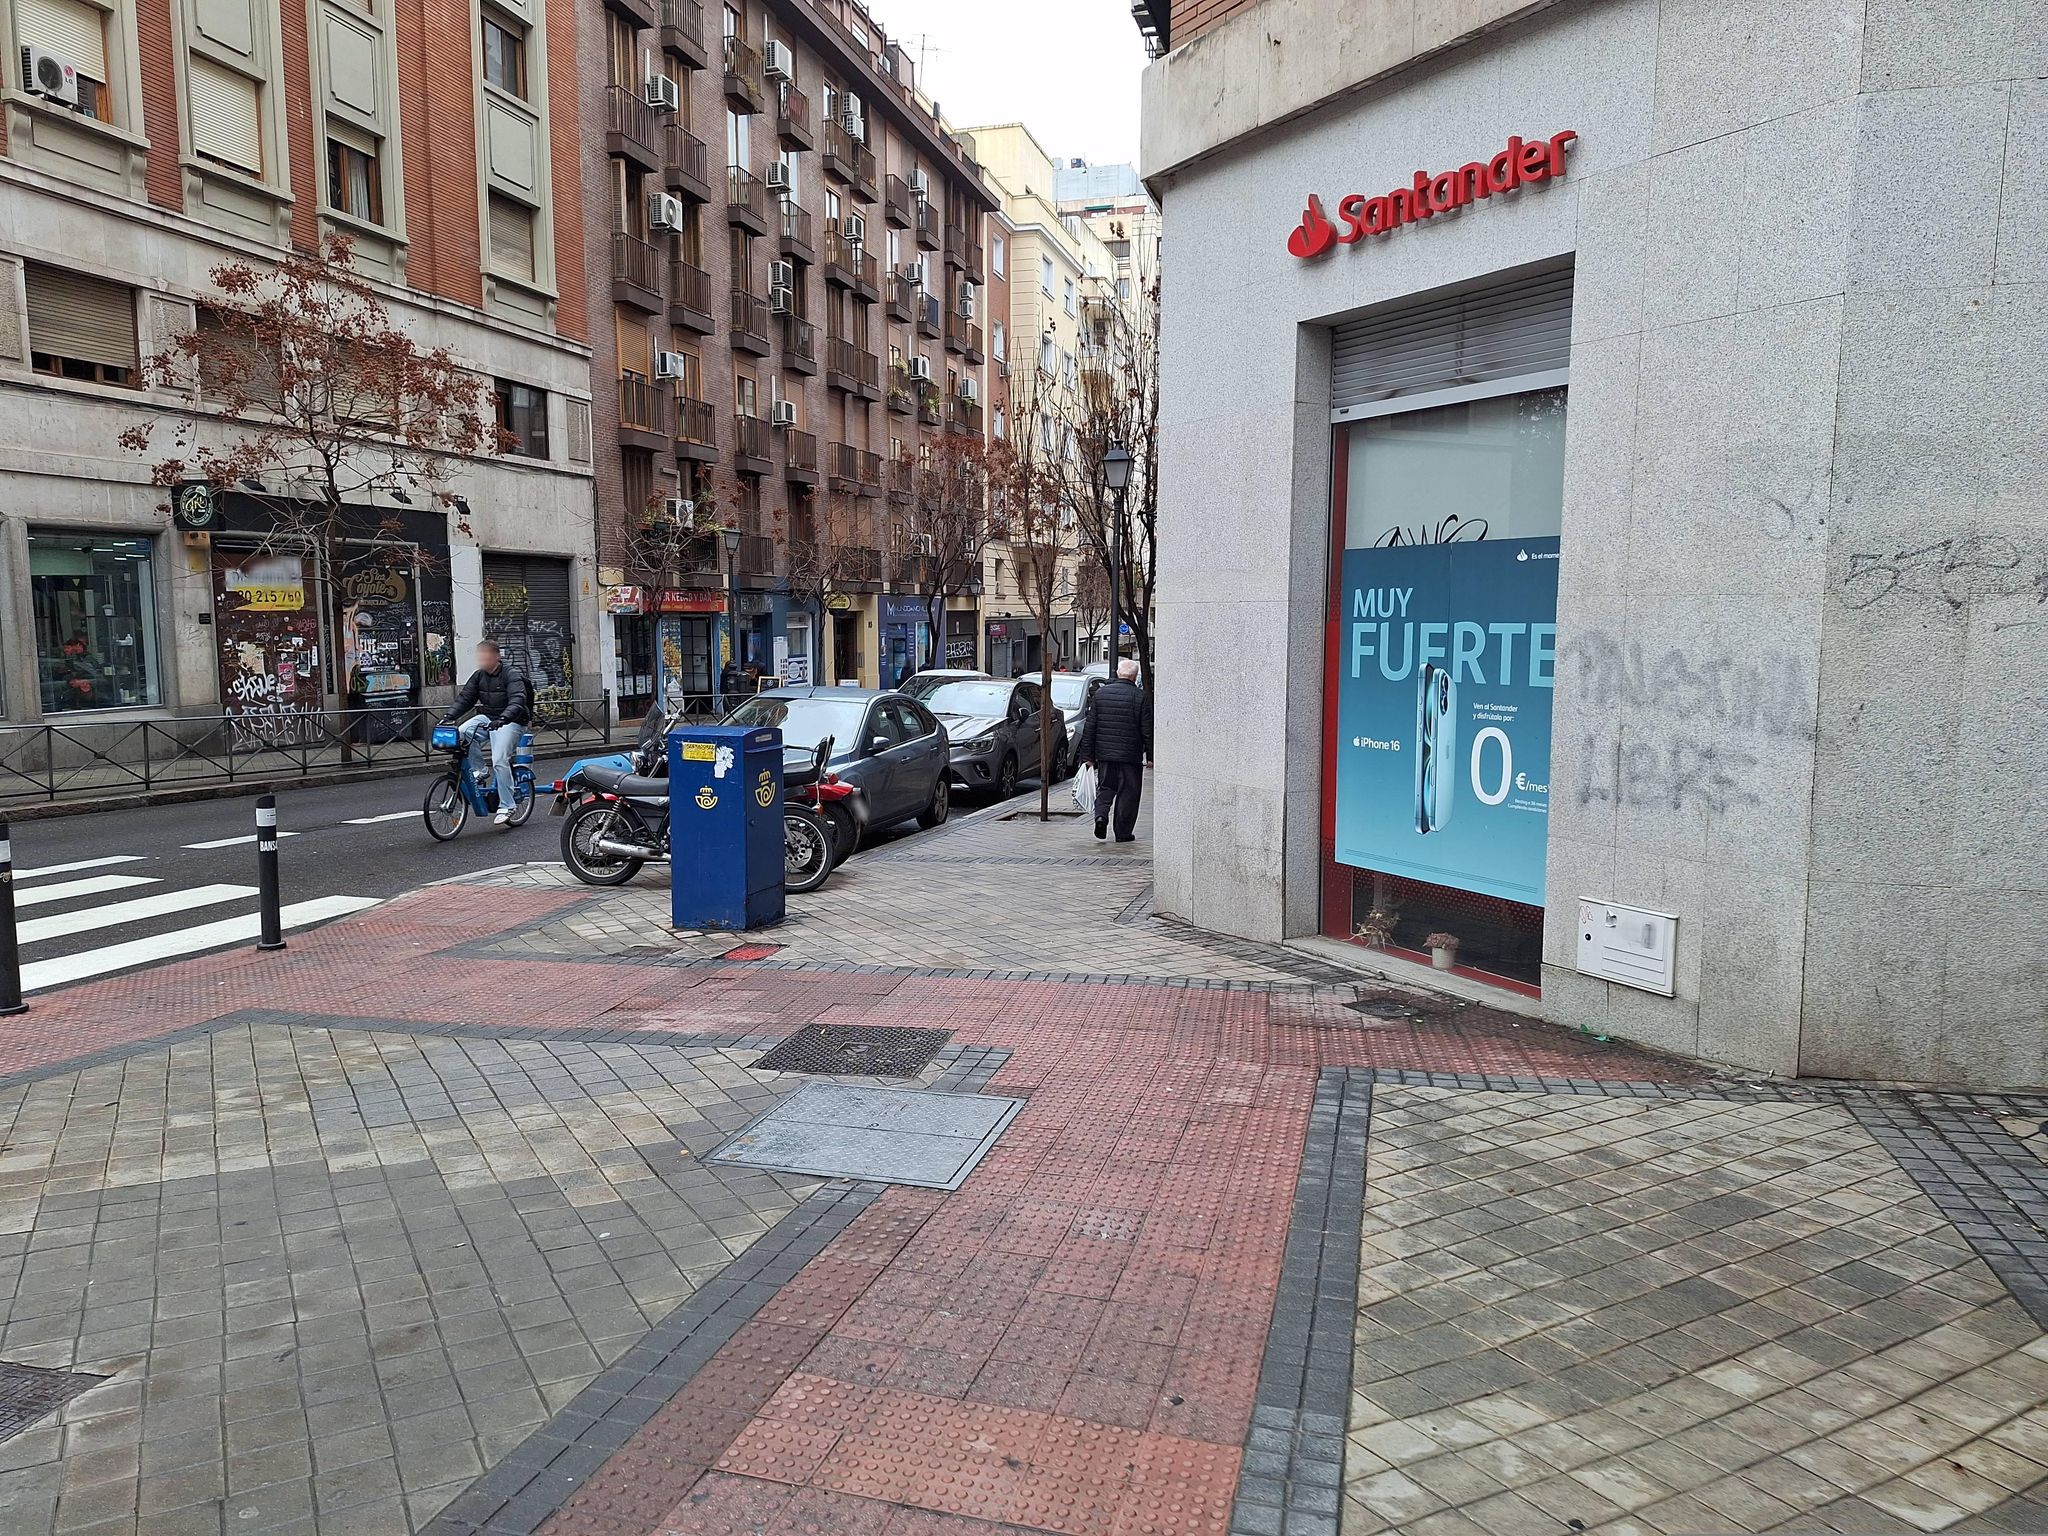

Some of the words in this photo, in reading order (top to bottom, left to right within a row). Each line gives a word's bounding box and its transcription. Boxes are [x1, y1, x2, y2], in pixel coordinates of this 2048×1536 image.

[1337, 130, 1577, 244] Santander
[256, 590, 277, 602] 215
[1353, 588, 1413, 618] MUY
[1351, 621, 1557, 687] FUERTE
[1473, 702, 1484, 710] Ven
[1490, 703, 1519, 713] Santander
[1361, 737, 1390, 750] iPhone
[1390, 740, 1401, 751] 16
[1471, 727, 1512, 805] 0
